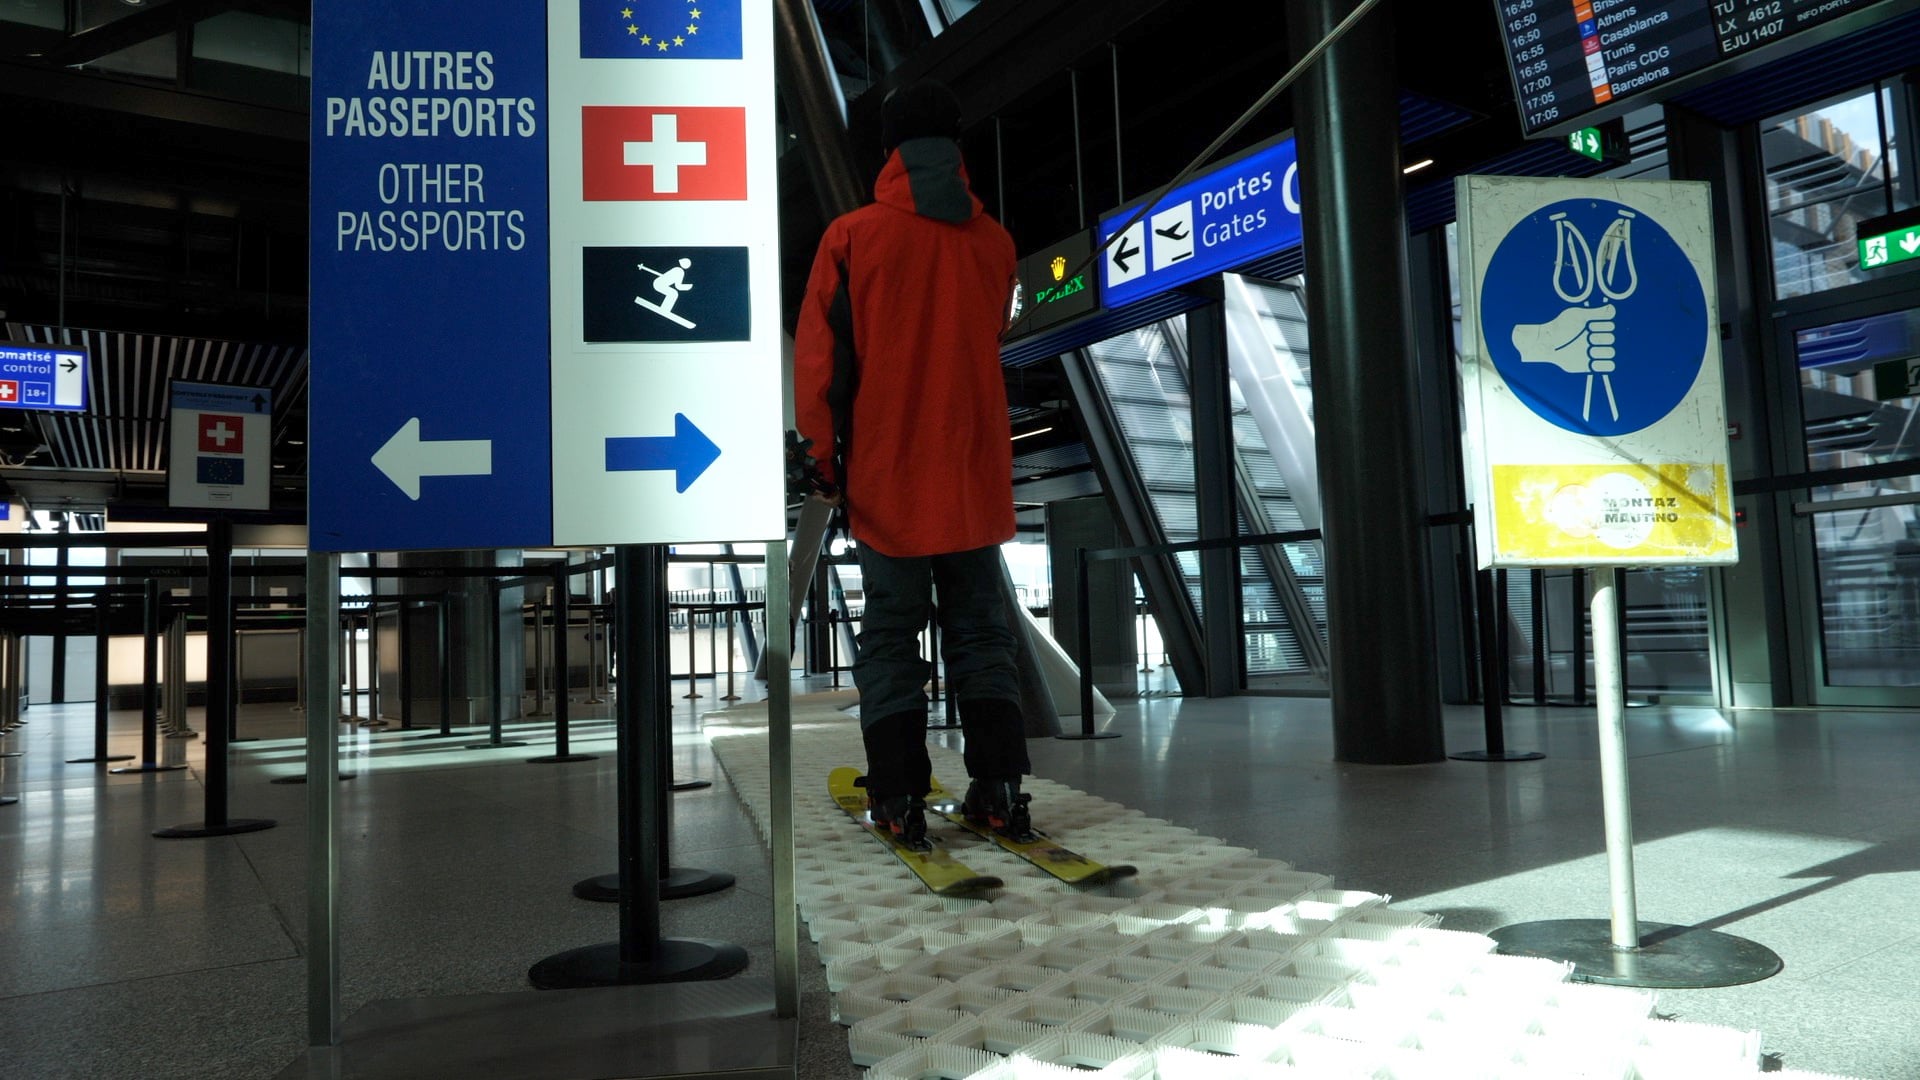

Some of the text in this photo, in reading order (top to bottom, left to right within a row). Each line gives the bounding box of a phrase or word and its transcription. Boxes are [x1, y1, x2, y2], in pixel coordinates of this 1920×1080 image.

[1509, 13, 1537, 33] 16:50
[1512, 29, 1541, 49] 16:50
[1515, 5, 1637, 64] 16:55 Athens
[1519, 10, 1669, 80] 16:55 Casablanca
[1523, 0, 1735, 95] 17:00 Tunis TU
[1526, 1, 1782, 111] 17:05 Paris CDG LX 4612
[367, 51, 494, 91] AUTRES
[1529, 108, 1559, 127] 17:05
[1611, 65, 1670, 95] Barcelona
[1722, 33, 1750, 52] EJU
[1752, 19, 1785, 41] 1407
[1797, 8, 1818, 22] INFO
[326, 97, 536, 137] PASSEPORTS
[379, 163, 484, 204] OTHER
[1201, 170, 1272, 215] Portes
[337, 210, 526, 251] PASSPORTS
[1202, 208, 1267, 248] Gates
[3, 363, 51, 374] control
